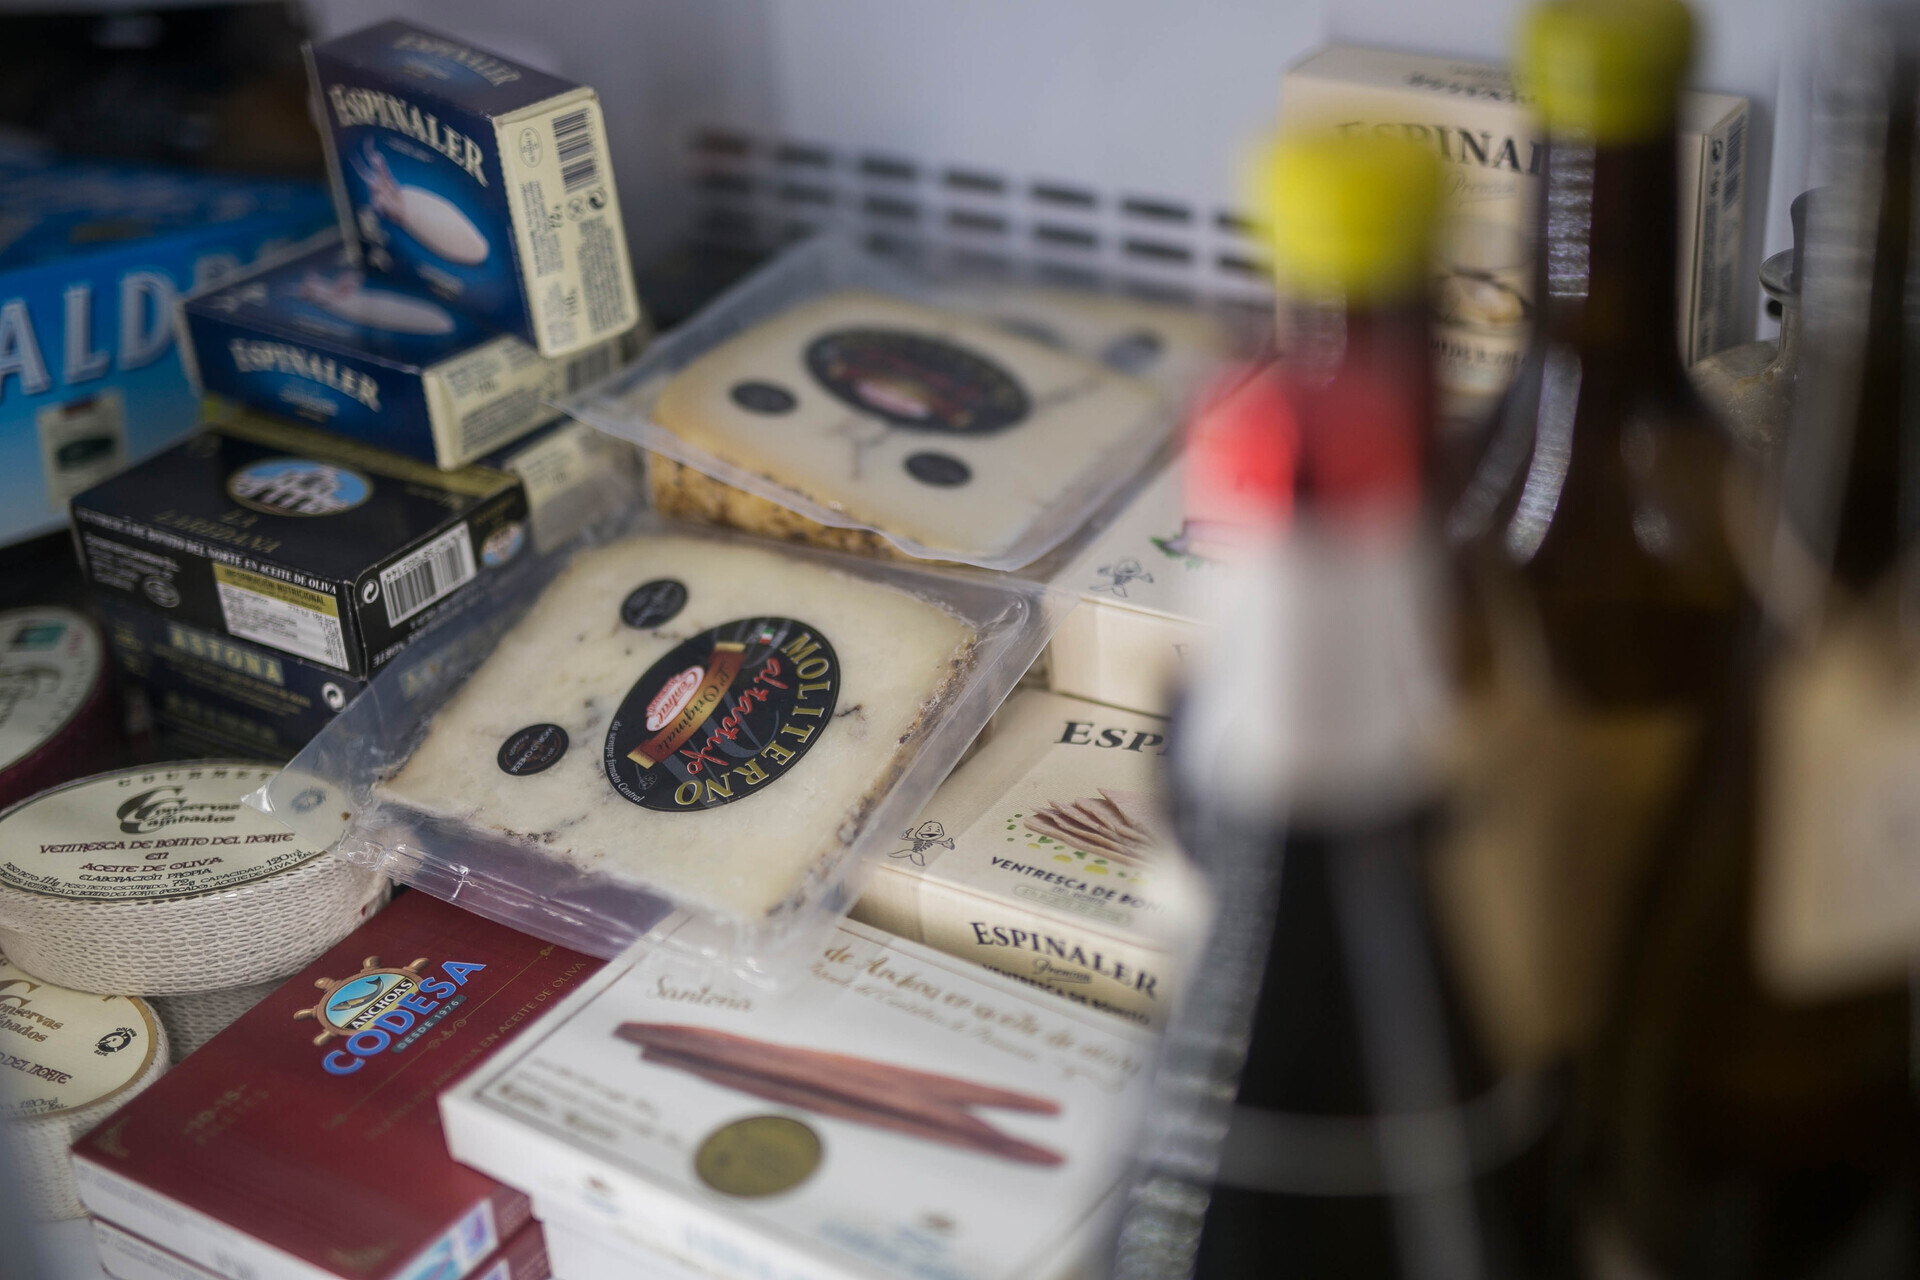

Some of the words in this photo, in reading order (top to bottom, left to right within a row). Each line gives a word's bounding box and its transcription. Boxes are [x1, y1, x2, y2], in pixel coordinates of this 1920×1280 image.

[327, 83, 490, 189] ESPINALER
[207, 546, 242, 568] NORTE
[244, 559, 258, 573] EN
[260, 561, 292, 585] ACEITE
[293, 572, 308, 588] DE
[308, 578, 338, 596] OLIVA
[654, 670, 700, 728] Central
[675, 632, 831, 805] MOLITERNO
[604, 732, 617, 759] sempre
[680, 687, 769, 775] tartufo
[605, 758, 622, 785] firmato
[617, 782, 646, 803] Central
[40, 840, 126, 855] VENTRESCA
[129, 839, 154, 850] DE
[155, 837, 210, 849] BONITO
[211, 835, 242, 846] DEL
[245, 832, 296, 846] NORTE
[79, 862, 140, 873] ACEITE
[141, 864, 166, 873] DE
[169, 857, 225, 870] OLIVA
[166, 868, 213, 880] PROPIA
[263, 861, 292, 874] OLIVA
[990, 855, 1088, 892] VENTRESCA
[1091, 884, 1117, 900] DE
[969, 921, 1158, 1000] ESPINALER
[1032, 957, 1093, 985] Premium
[322, 959, 488, 1077] CODESA
[351, 979, 413, 1031] ANCHOAS
[397, 1020, 435, 1050] DESDE
[434, 999, 460, 1020] 1976
[479, 1032, 499, 1049] EN
[498, 1001, 538, 1036] ACEITE
[534, 985, 550, 1003] DE
[551, 961, 588, 990] OLIVA
[5, 1055, 31, 1073] DEL
[26, 1063, 73, 1085] NORTE
